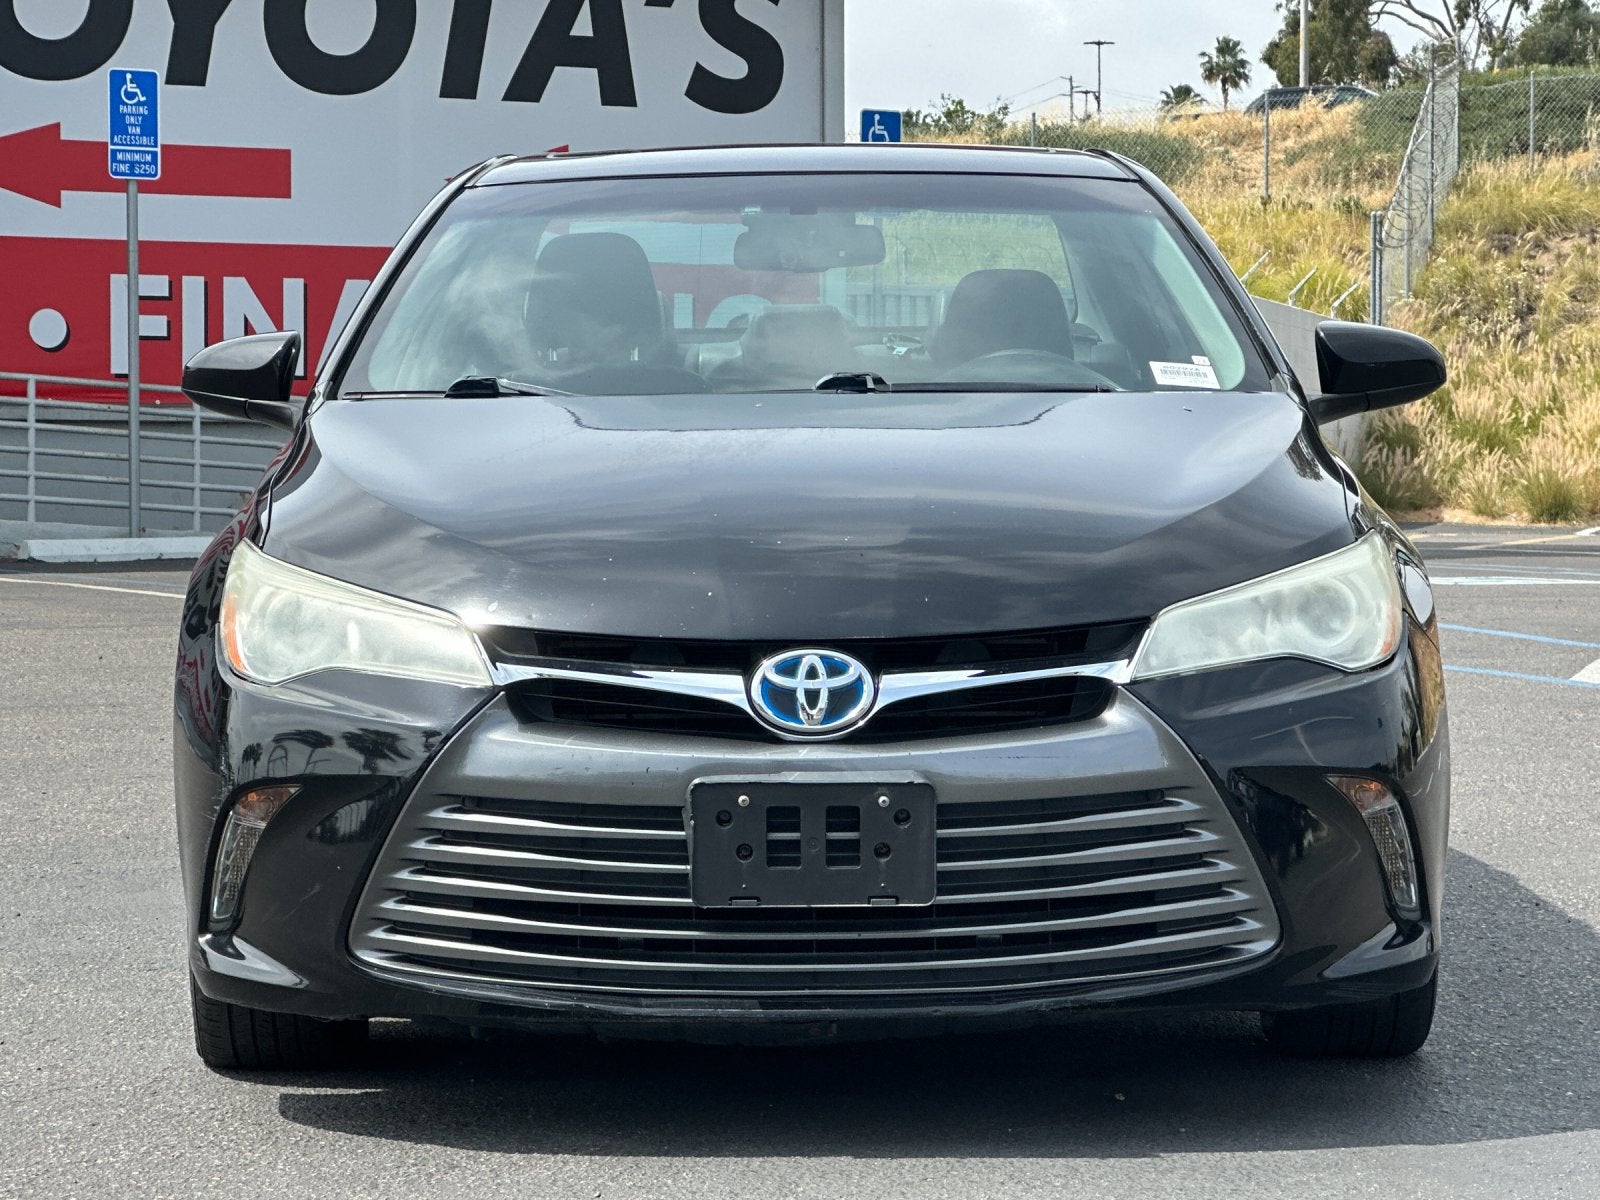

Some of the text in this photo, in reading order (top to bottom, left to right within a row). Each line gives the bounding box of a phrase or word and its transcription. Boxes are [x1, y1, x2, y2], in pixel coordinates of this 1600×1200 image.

[0, 0, 784, 114] OYOAS
[119, 104, 149, 115] PARKING
[125, 116, 142, 125] ONLY
[127, 125, 141, 135] VAN
[113, 135, 155, 146] ACCESSIBLE
[116, 151, 152, 163] MINIMUM
[112, 163, 156, 175] FINE $250
